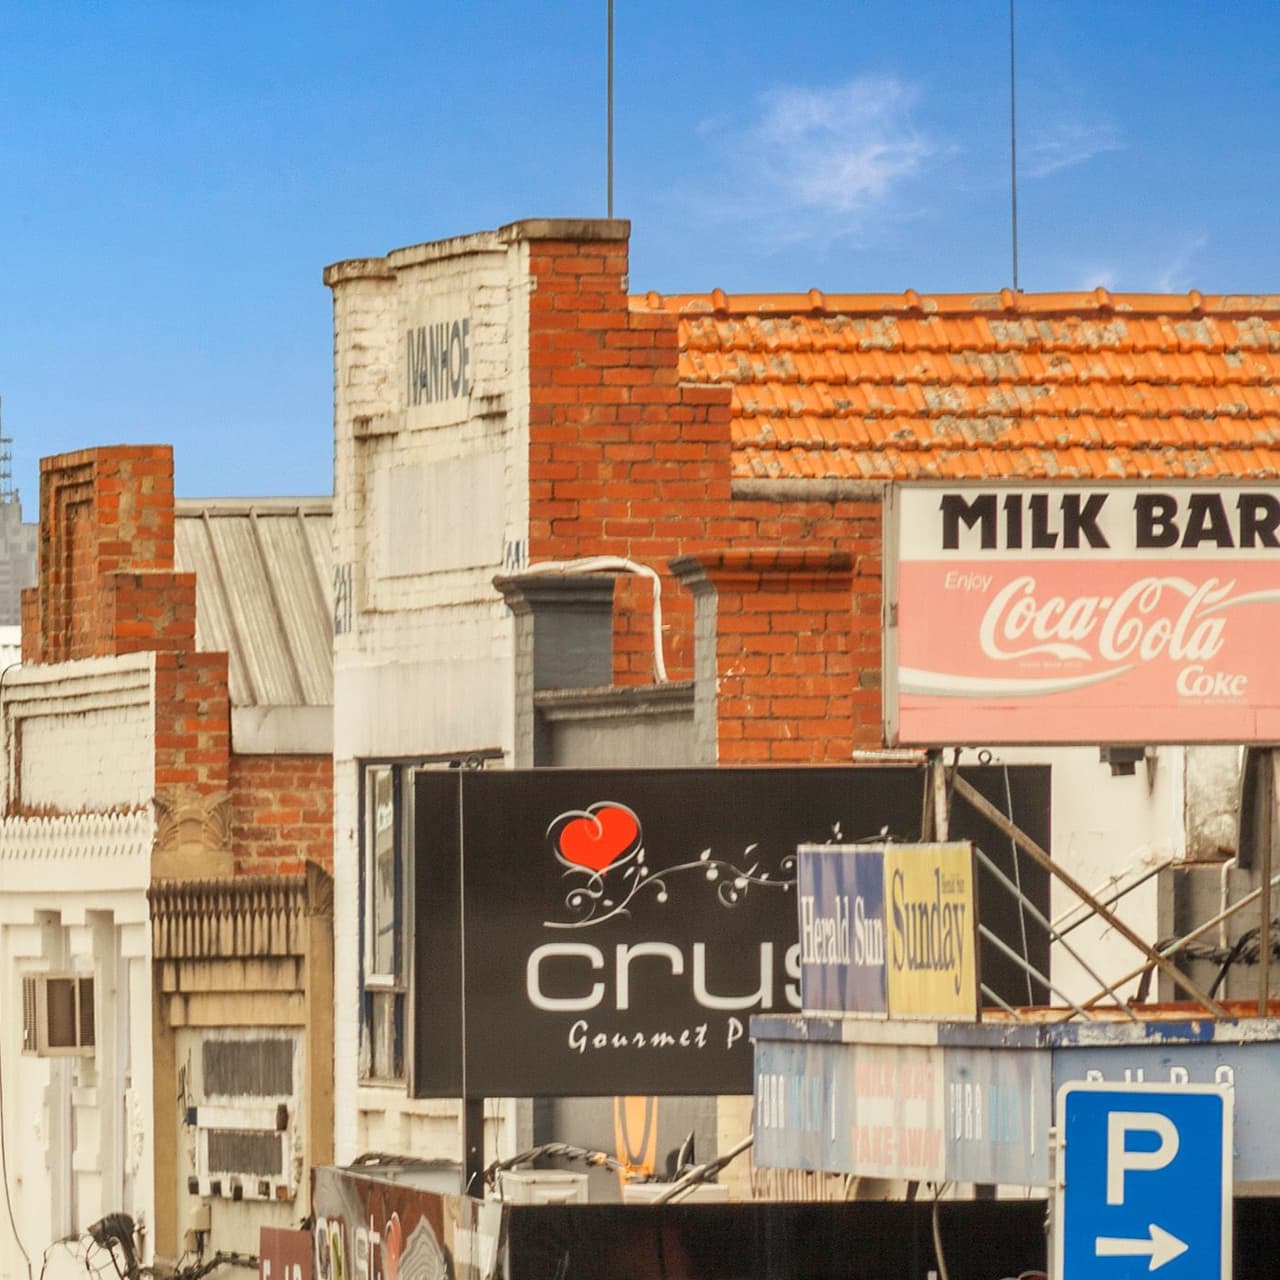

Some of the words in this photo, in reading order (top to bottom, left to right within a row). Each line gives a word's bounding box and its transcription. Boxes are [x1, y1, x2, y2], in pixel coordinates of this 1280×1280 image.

[406, 319, 471, 405] IVANHOE
[939, 493, 1111, 550] MILK
[1133, 493, 1280, 549] BAR
[944, 571, 993, 592] Enjoy
[1175, 664, 1249, 698] Coke
[801, 895, 851, 965] Herald
[854, 895, 885, 967] Sun
[892, 866, 966, 997] Sunday
[526, 941, 802, 1012] cru
[568, 1019, 709, 1051] Gourmet
[1106, 1110, 1180, 1206] P
